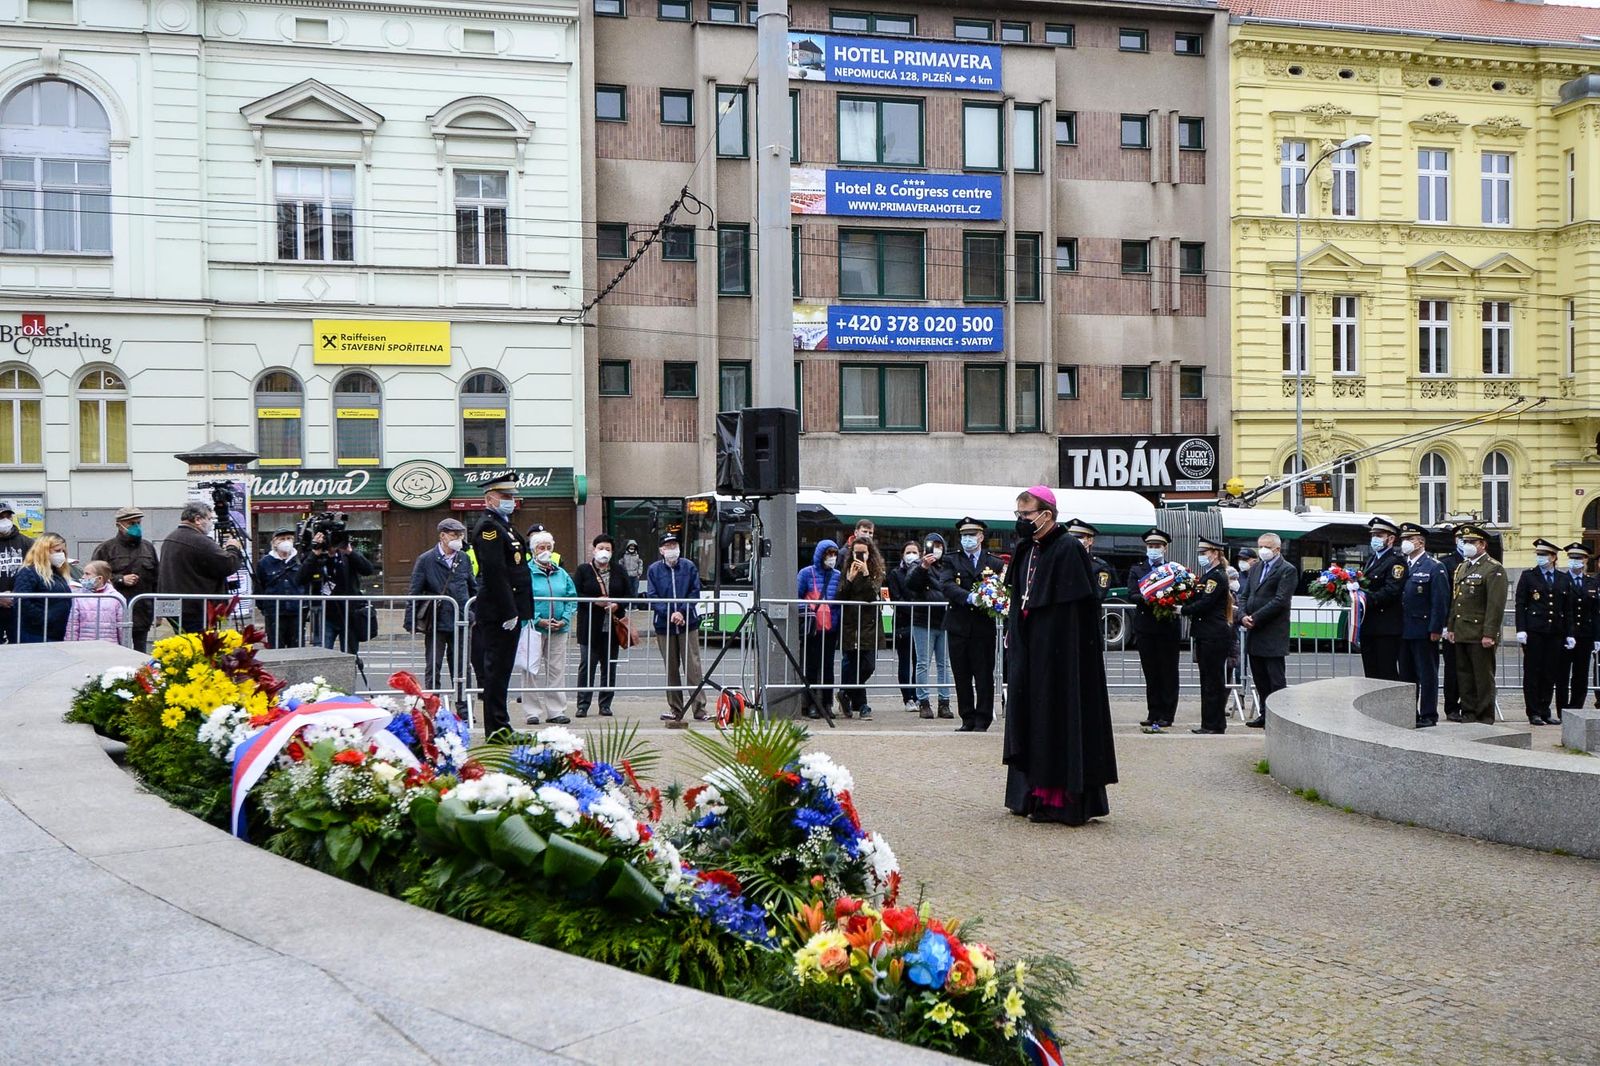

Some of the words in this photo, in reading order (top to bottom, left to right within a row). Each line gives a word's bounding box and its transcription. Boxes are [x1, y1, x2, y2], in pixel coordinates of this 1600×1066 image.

[834, 46, 889, 64] HOTEL
[894, 50, 993, 69] PRIMAVERA
[834, 67, 898, 80] NEPOMUCKÁ
[900, 71, 920, 82] 128,
[922, 71, 952, 83] PLZEŇ
[970, 75, 976, 85] 4
[978, 75, 993, 85] km
[835, 182, 871, 195] Hotel
[875, 183, 887, 195] &
[890, 184, 949, 200] Congress
[952, 187, 993, 199] centre
[848, 201, 981, 214] WWW.PRIMAVERAHOTEL.CZ
[0, 319, 63, 343] Broker
[836, 315, 882, 332] +420
[887, 316, 919, 332] 378
[924, 316, 957, 332] 020
[962, 317, 994, 332] 500
[13, 332, 112, 355] Consulting
[341, 333, 387, 342] Raiffeisen
[836, 335, 889, 345] UBYTOVÁNÍ
[896, 336, 954, 346] KONFERENCE
[961, 336, 994, 346] SVATBY
[341, 342, 386, 351] STAVEBNÍ
[387, 343, 444, 352] SPOŘITELNA
[1186, 450, 1208, 458] LUCKY
[1067, 440, 1172, 487] TABÁK
[1184, 458, 1209, 466] STRIKE
[464, 471, 478, 483] Ta
